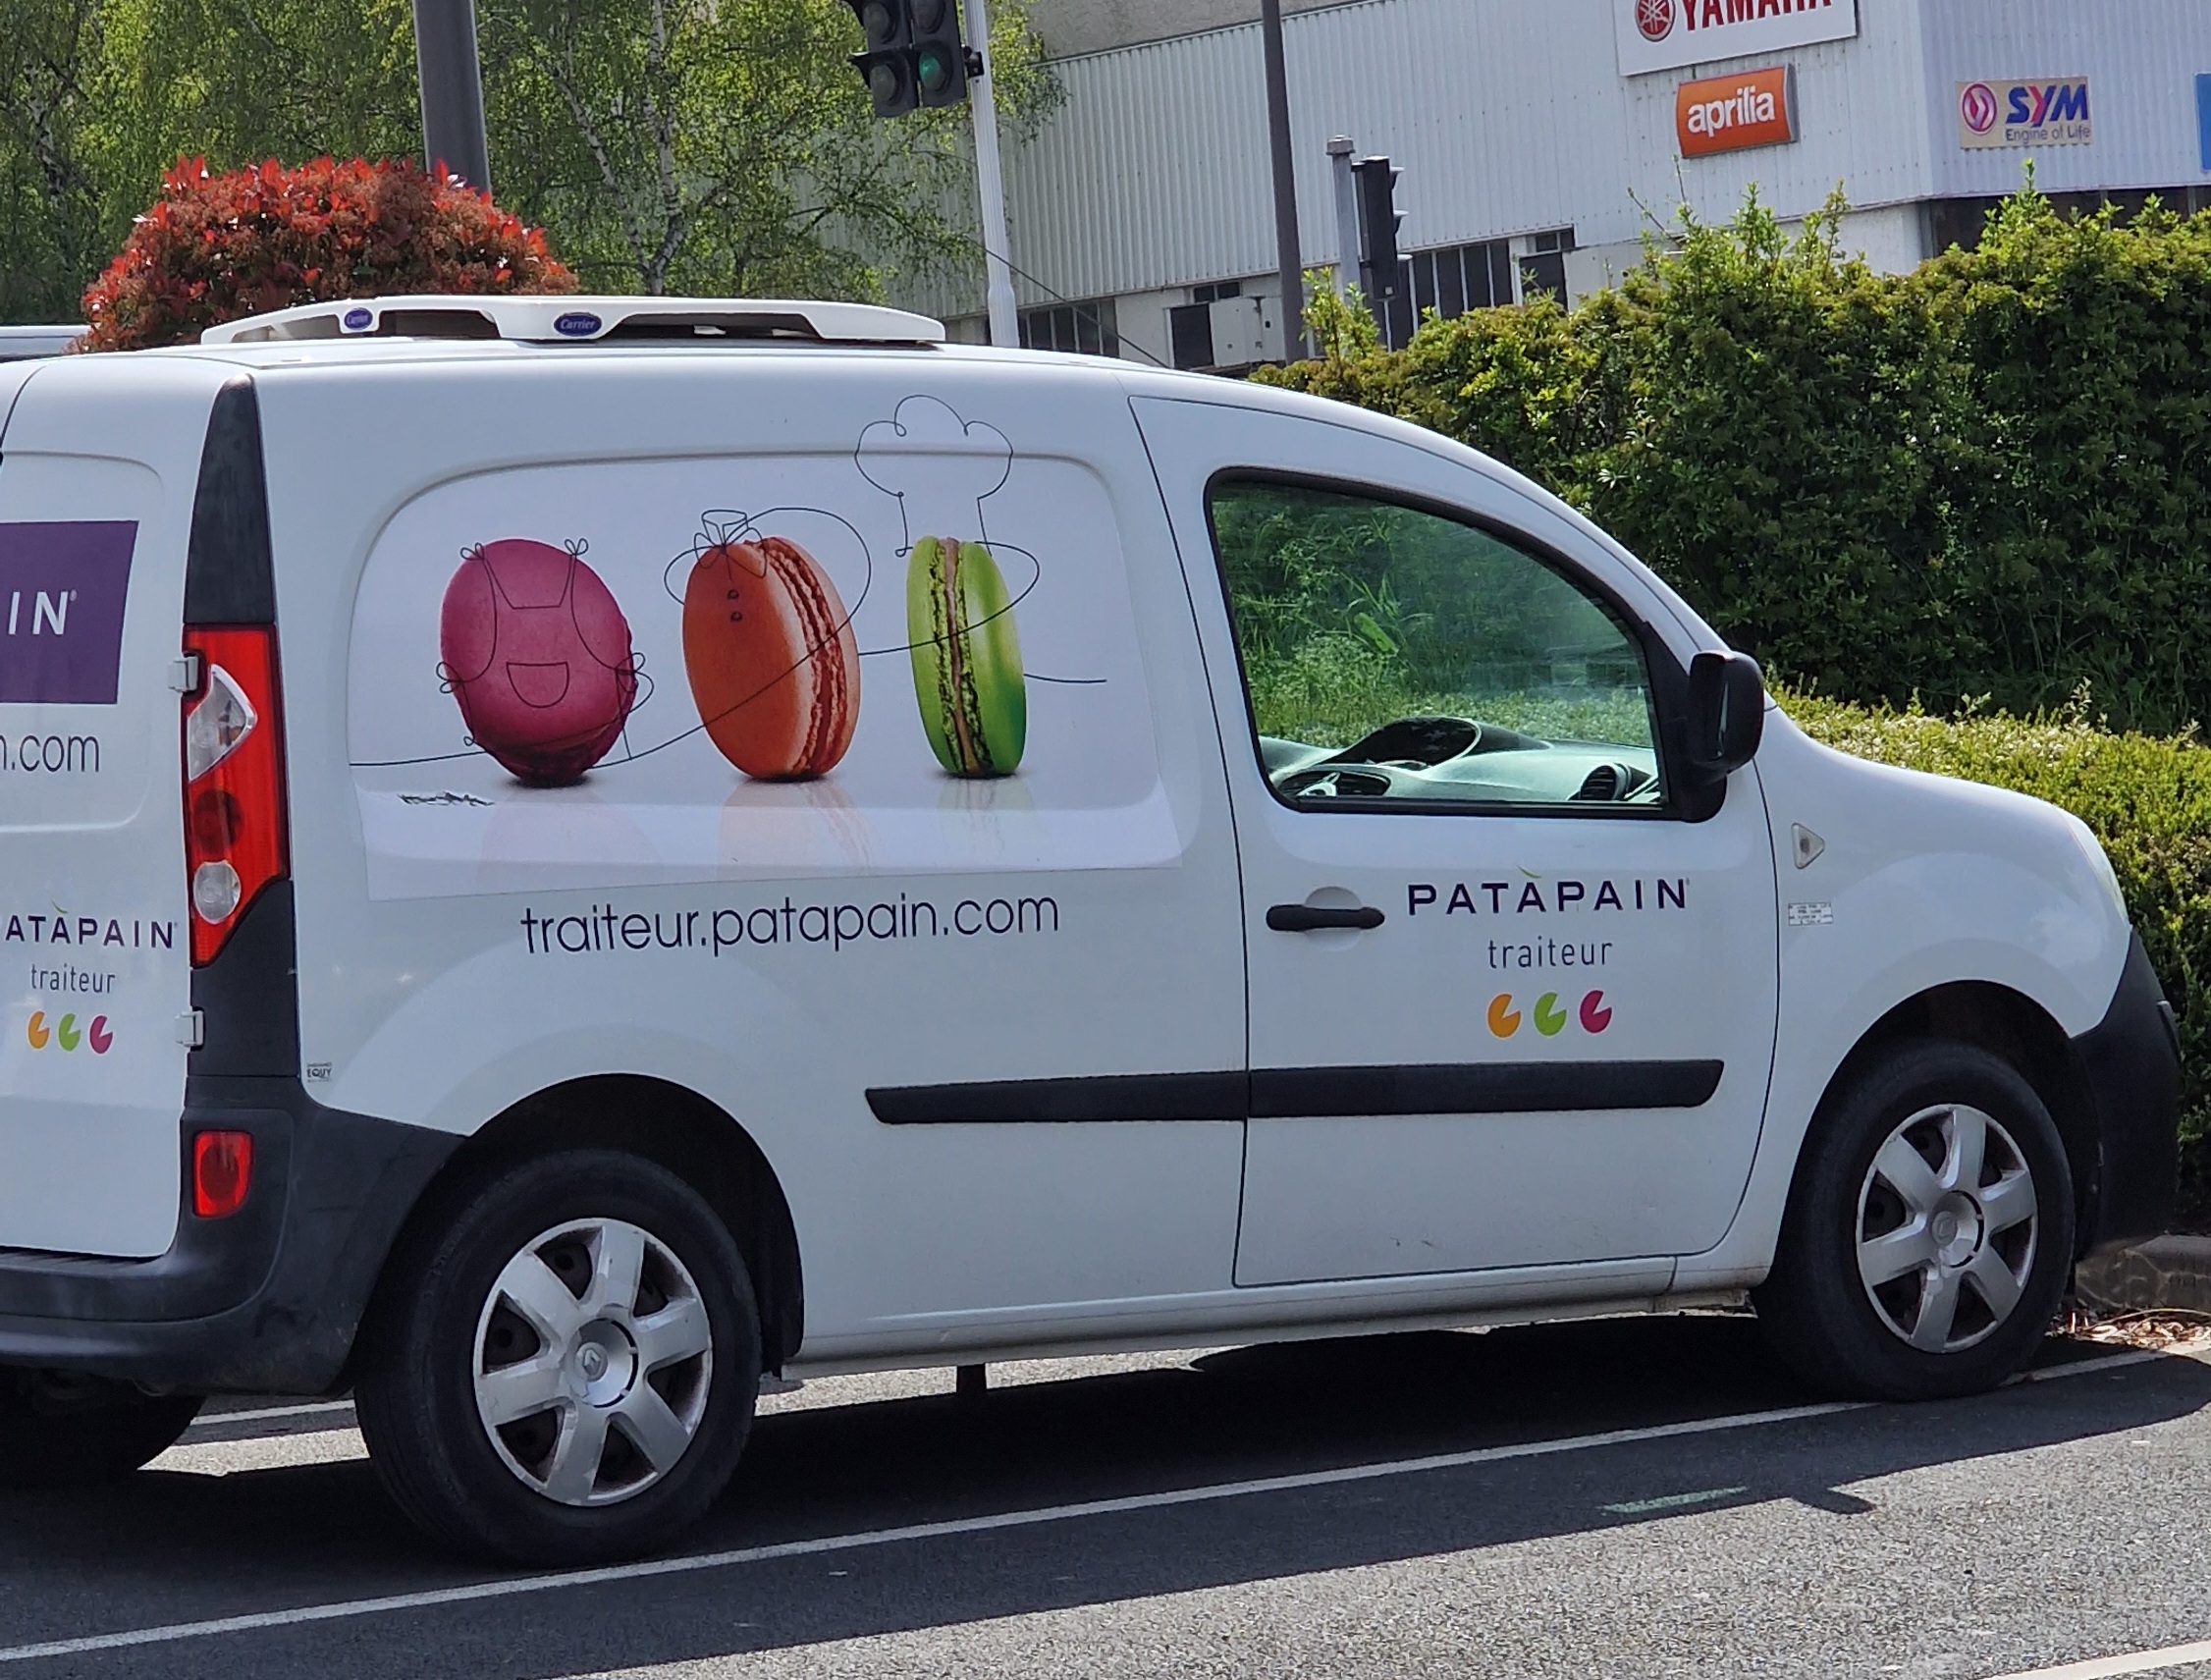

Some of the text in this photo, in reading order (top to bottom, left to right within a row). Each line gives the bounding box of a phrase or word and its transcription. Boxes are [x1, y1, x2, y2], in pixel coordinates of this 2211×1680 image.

[1682, 0, 1832, 30] YAMA
[1687, 84, 1776, 137] aprilia
[2005, 83, 2088, 128] SYM
[2005, 127, 2048, 143] Engine
[2067, 124, 2091, 140] Life
[560, 318, 596, 330] Carrier
[519, 893, 1059, 956] traiteur.patapain.com
[1487, 935, 1613, 969] traiteur
[30, 962, 116, 994] traiteur
